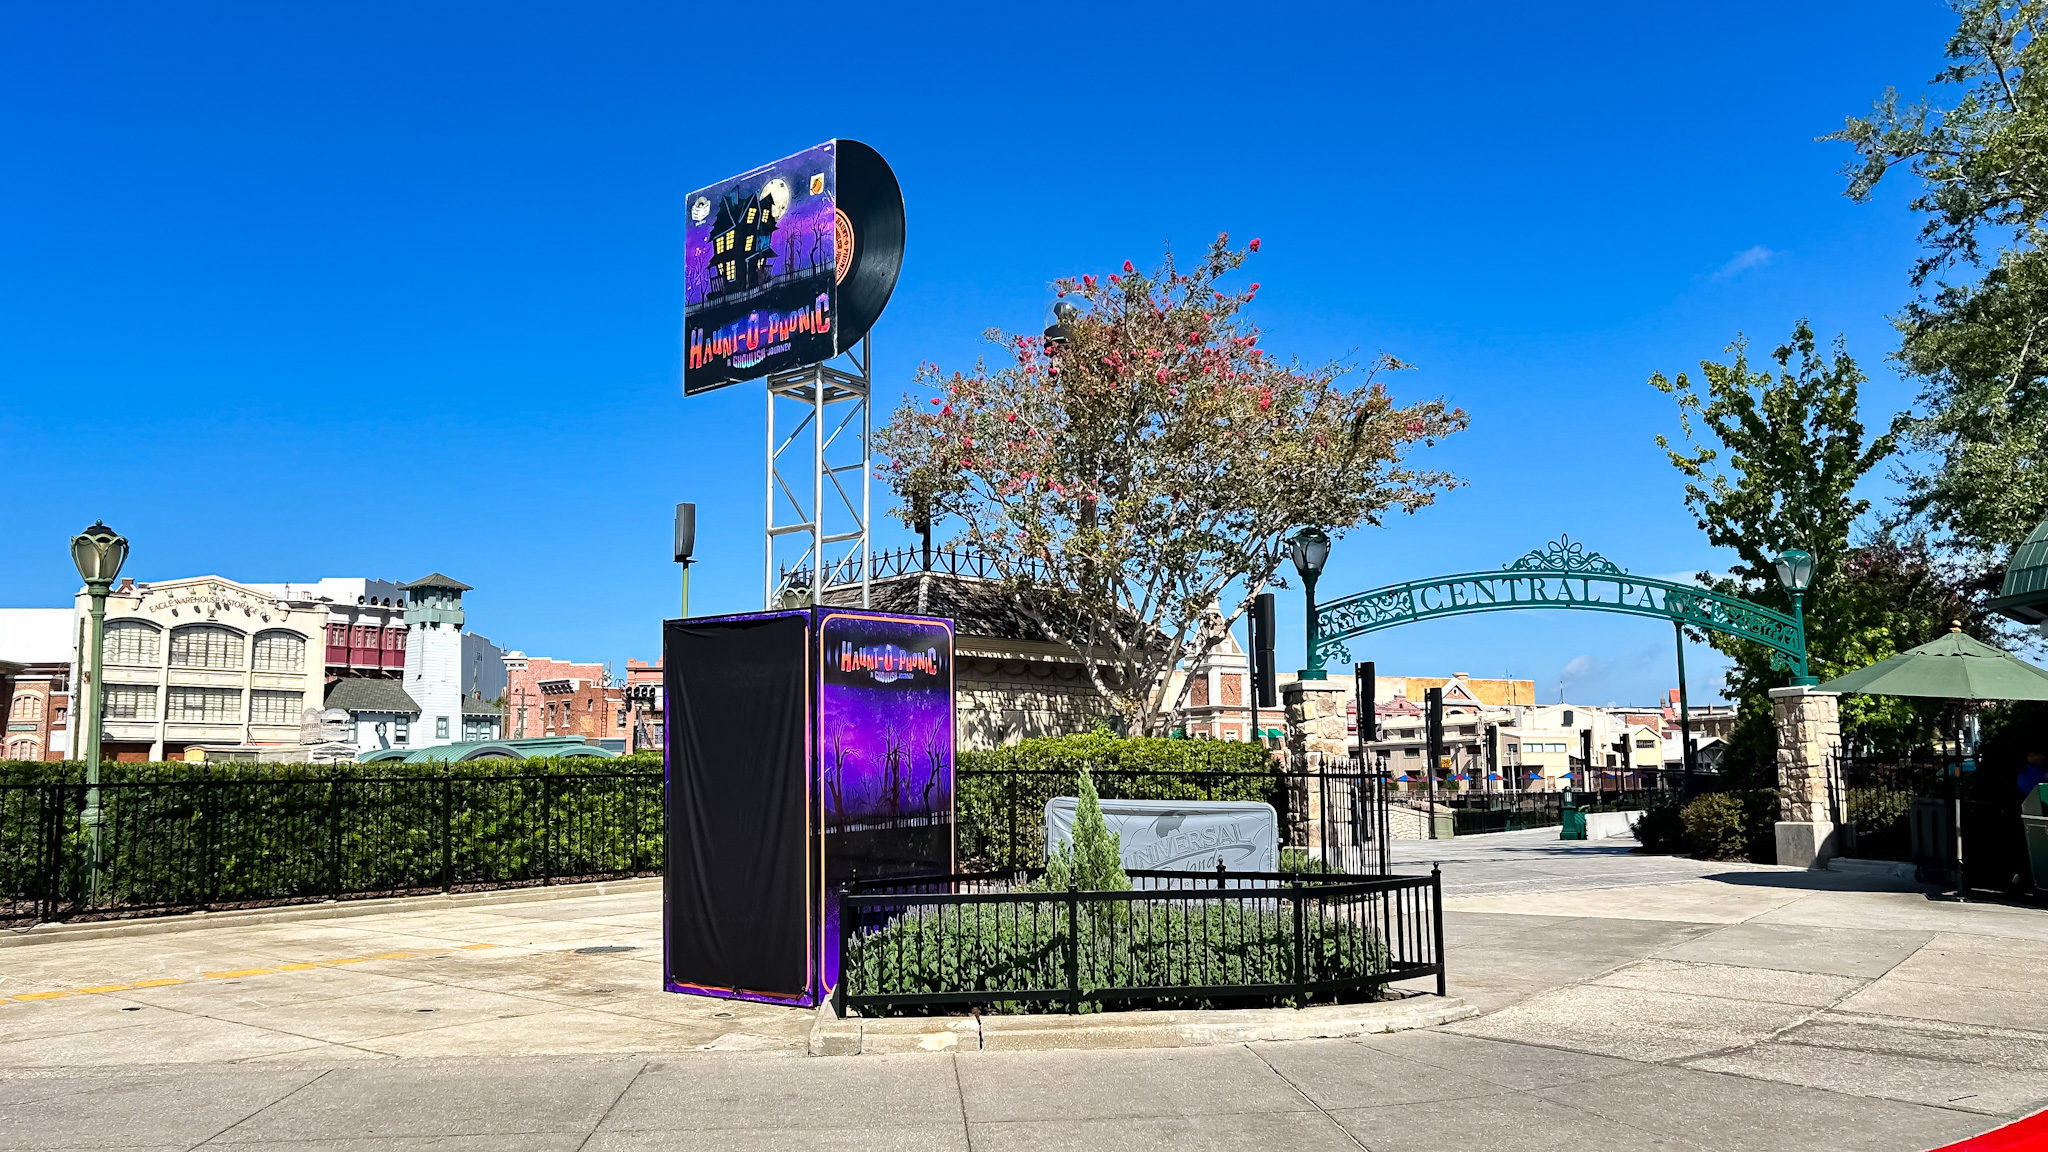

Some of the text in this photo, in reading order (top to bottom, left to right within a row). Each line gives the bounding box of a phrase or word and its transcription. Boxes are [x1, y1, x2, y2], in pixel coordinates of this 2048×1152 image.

[732, 348, 767, 369] GHOULISH
[766, 342, 792, 357] JOURNEY
[149, 600, 174, 613] EAGLE
[175, 596, 221, 605] WAREHOUSE
[226, 600, 259, 615] STORAGE
[1420, 577, 1712, 619] CENTRAL PARK
